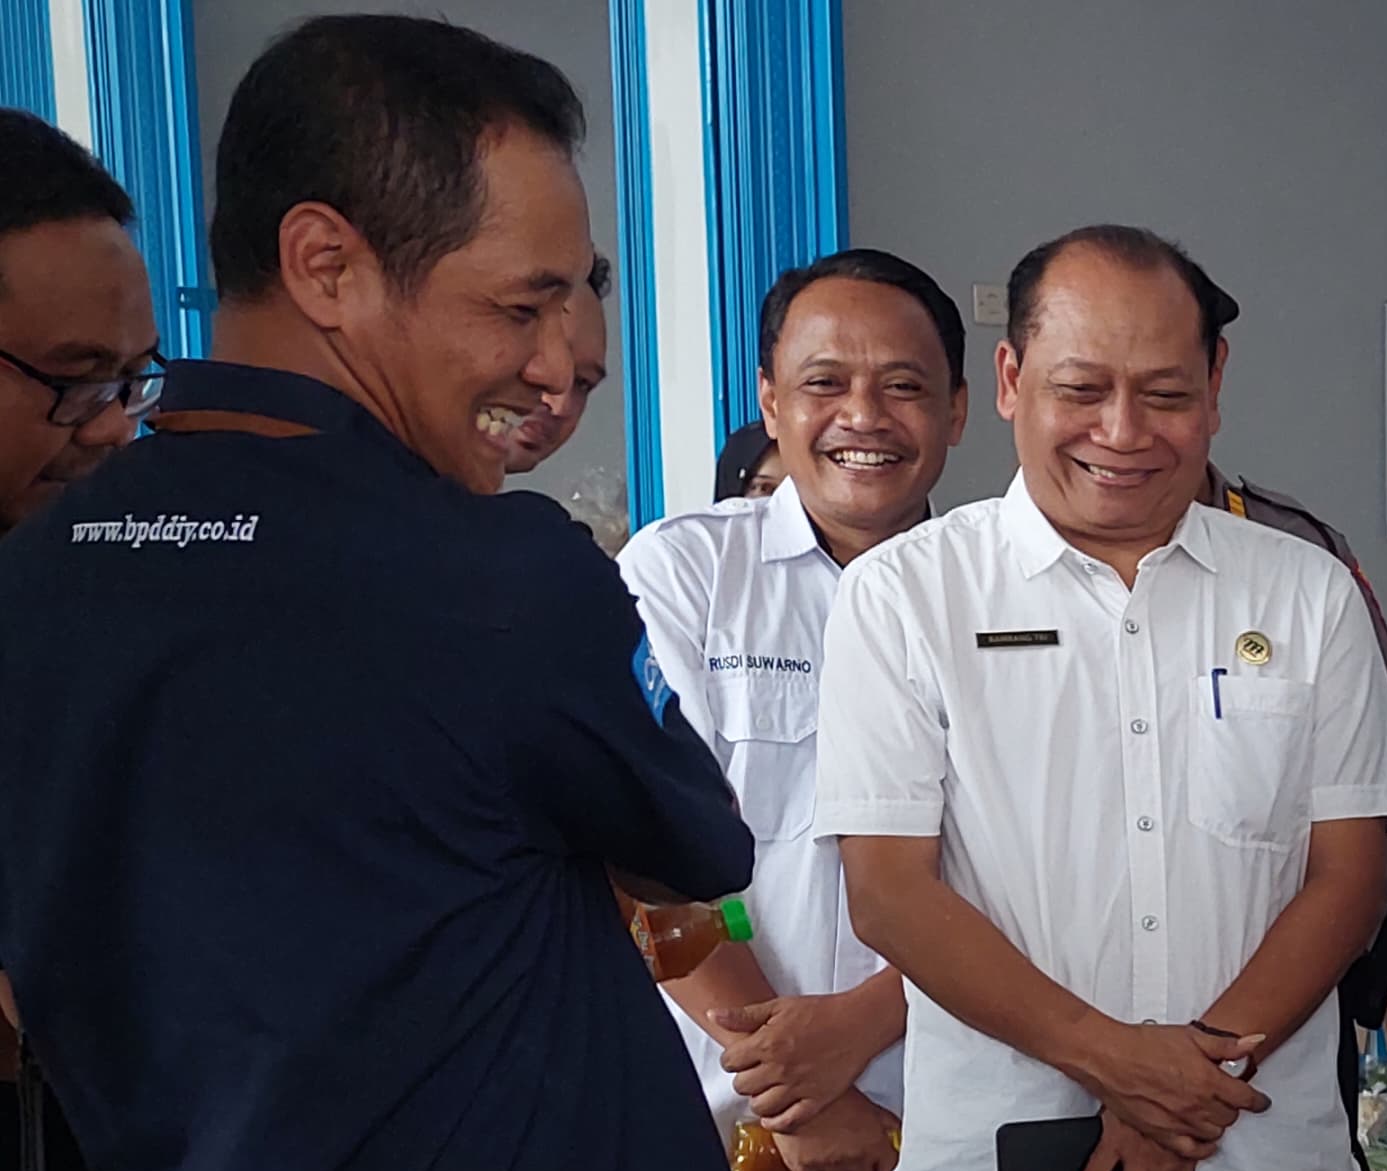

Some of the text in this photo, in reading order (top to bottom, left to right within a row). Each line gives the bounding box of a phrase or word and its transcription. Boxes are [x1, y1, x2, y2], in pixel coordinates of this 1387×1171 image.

[72, 514, 257, 548] www.bpddiy.co.id
[709, 656, 811, 673] RUSDI SUWARNO
